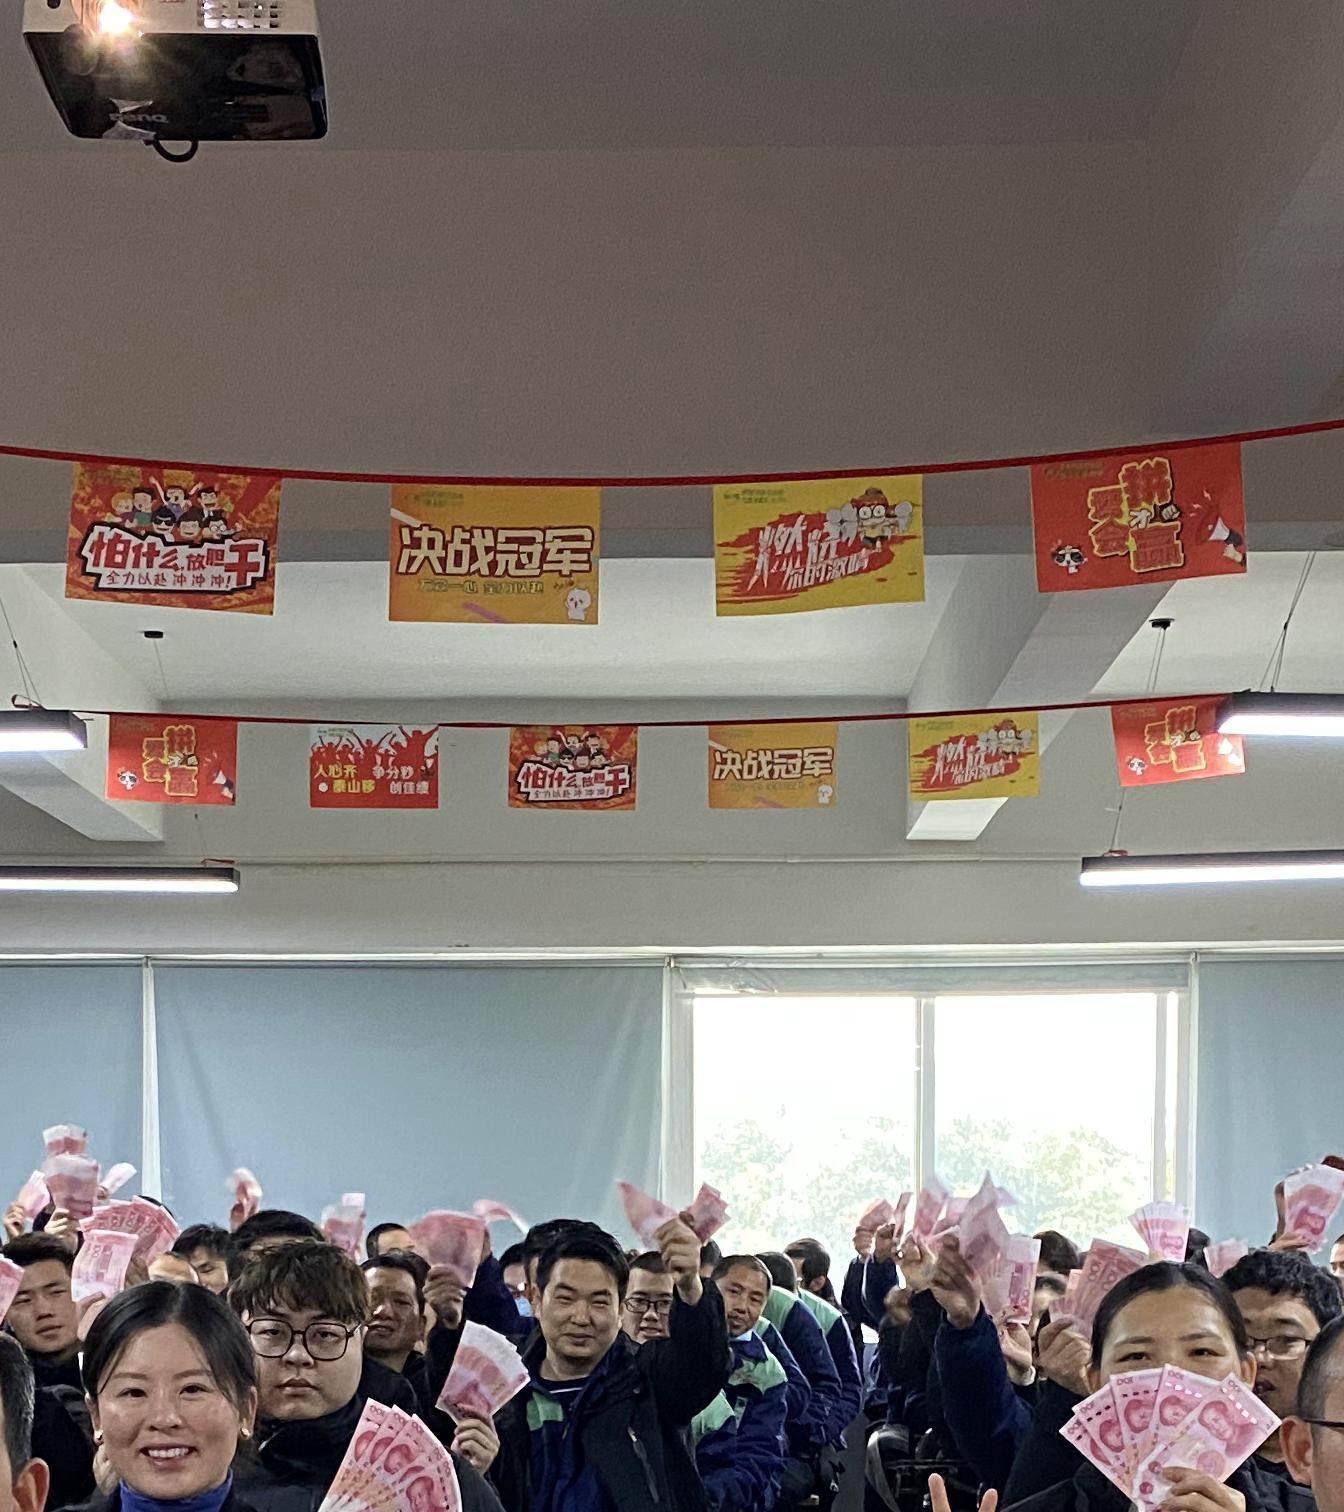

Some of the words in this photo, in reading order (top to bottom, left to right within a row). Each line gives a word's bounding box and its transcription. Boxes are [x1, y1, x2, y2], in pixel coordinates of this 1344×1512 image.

[397, 524, 595, 578] 决战冠军
[713, 746, 834, 780] 决战冠军
